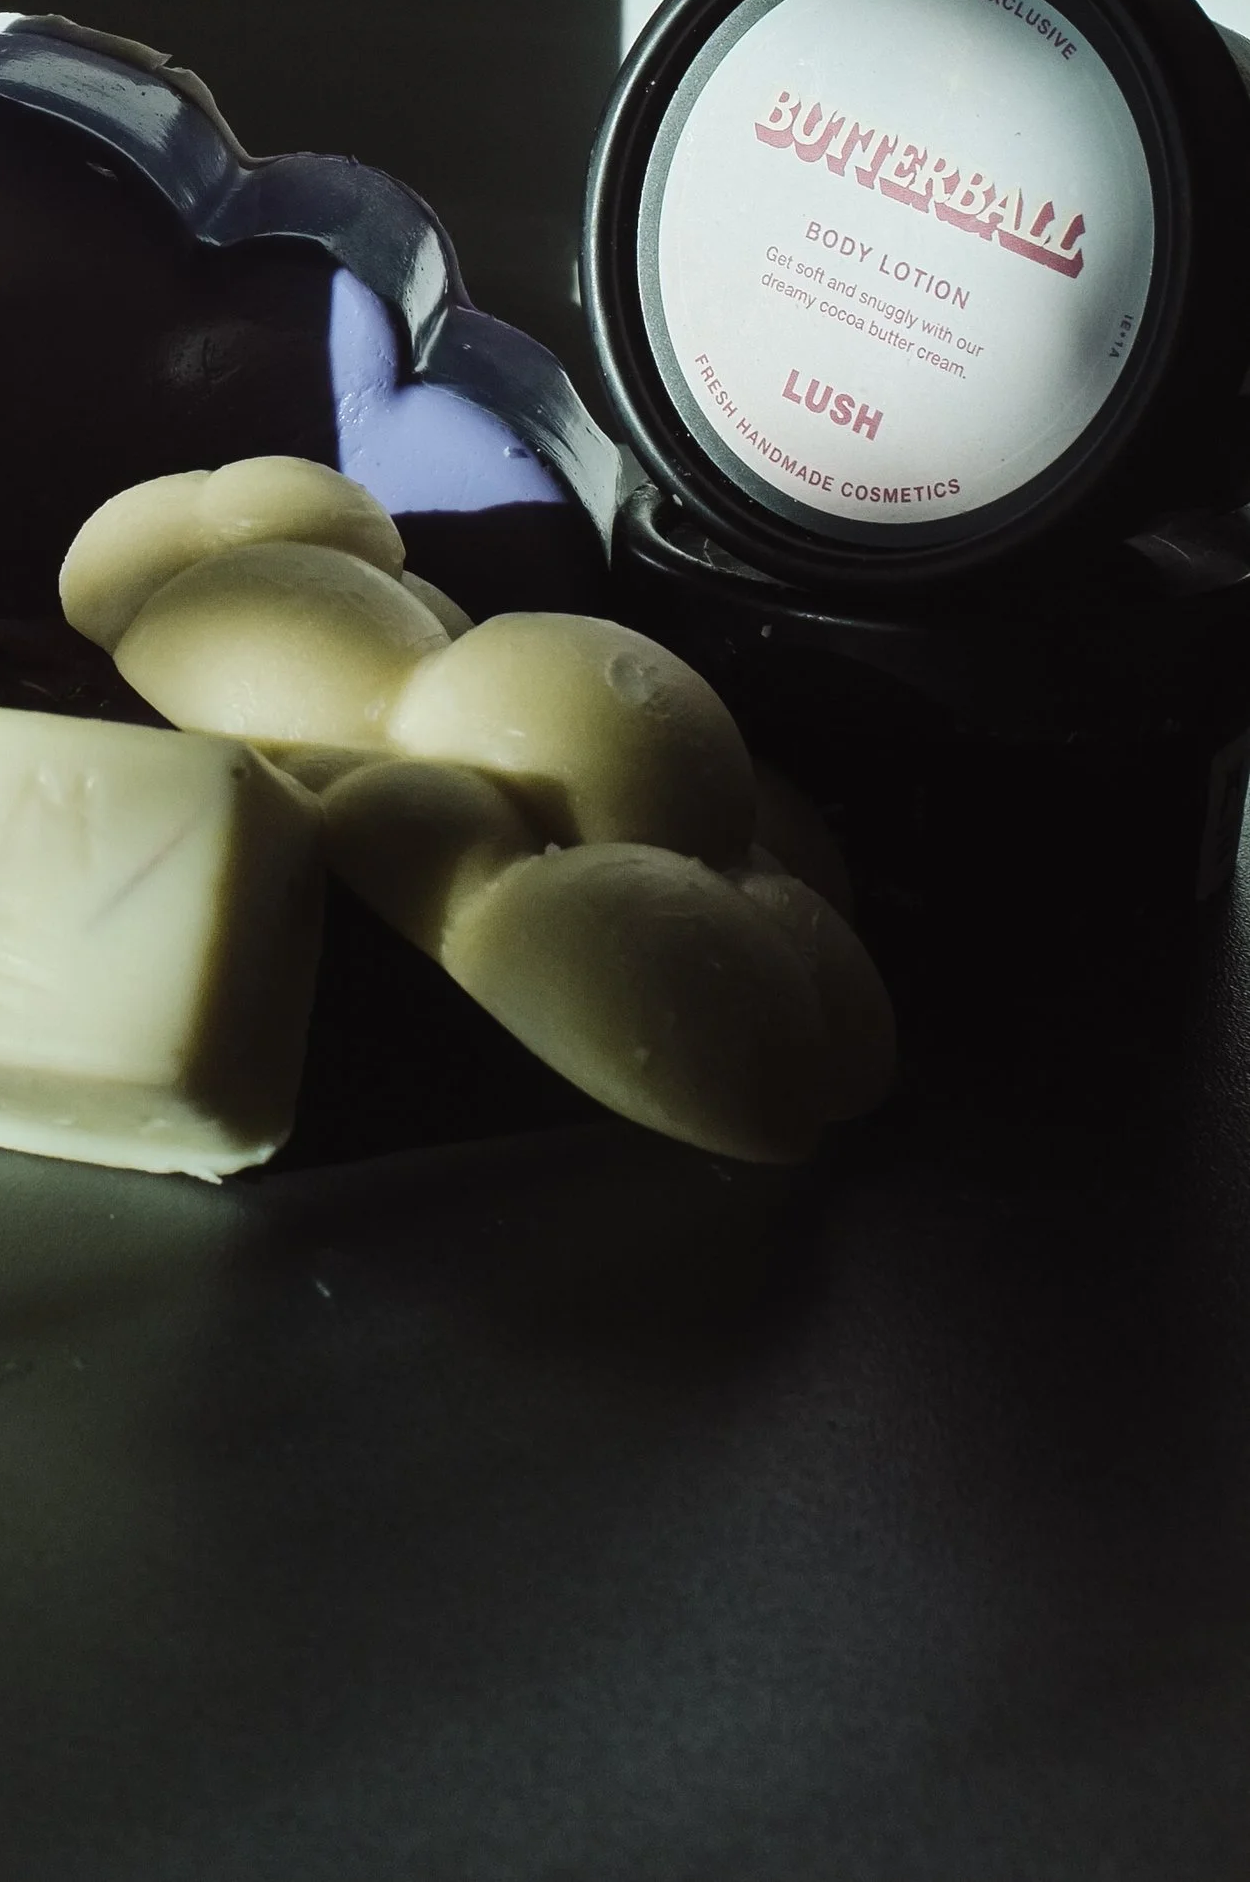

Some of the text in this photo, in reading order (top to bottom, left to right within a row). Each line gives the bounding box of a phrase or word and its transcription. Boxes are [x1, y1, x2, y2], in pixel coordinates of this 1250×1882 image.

[753, 88, 1086, 279] BUTTERBALL
[766, 246, 985, 357] Get soft and snuggly with our
[805, 221, 971, 310] BODY LOTION
[761, 272, 967, 380] dreamy cocoa butter cream.
[695, 354, 962, 504] FRESH HANDMADE COSMETICS
[781, 368, 884, 441] LUSH
